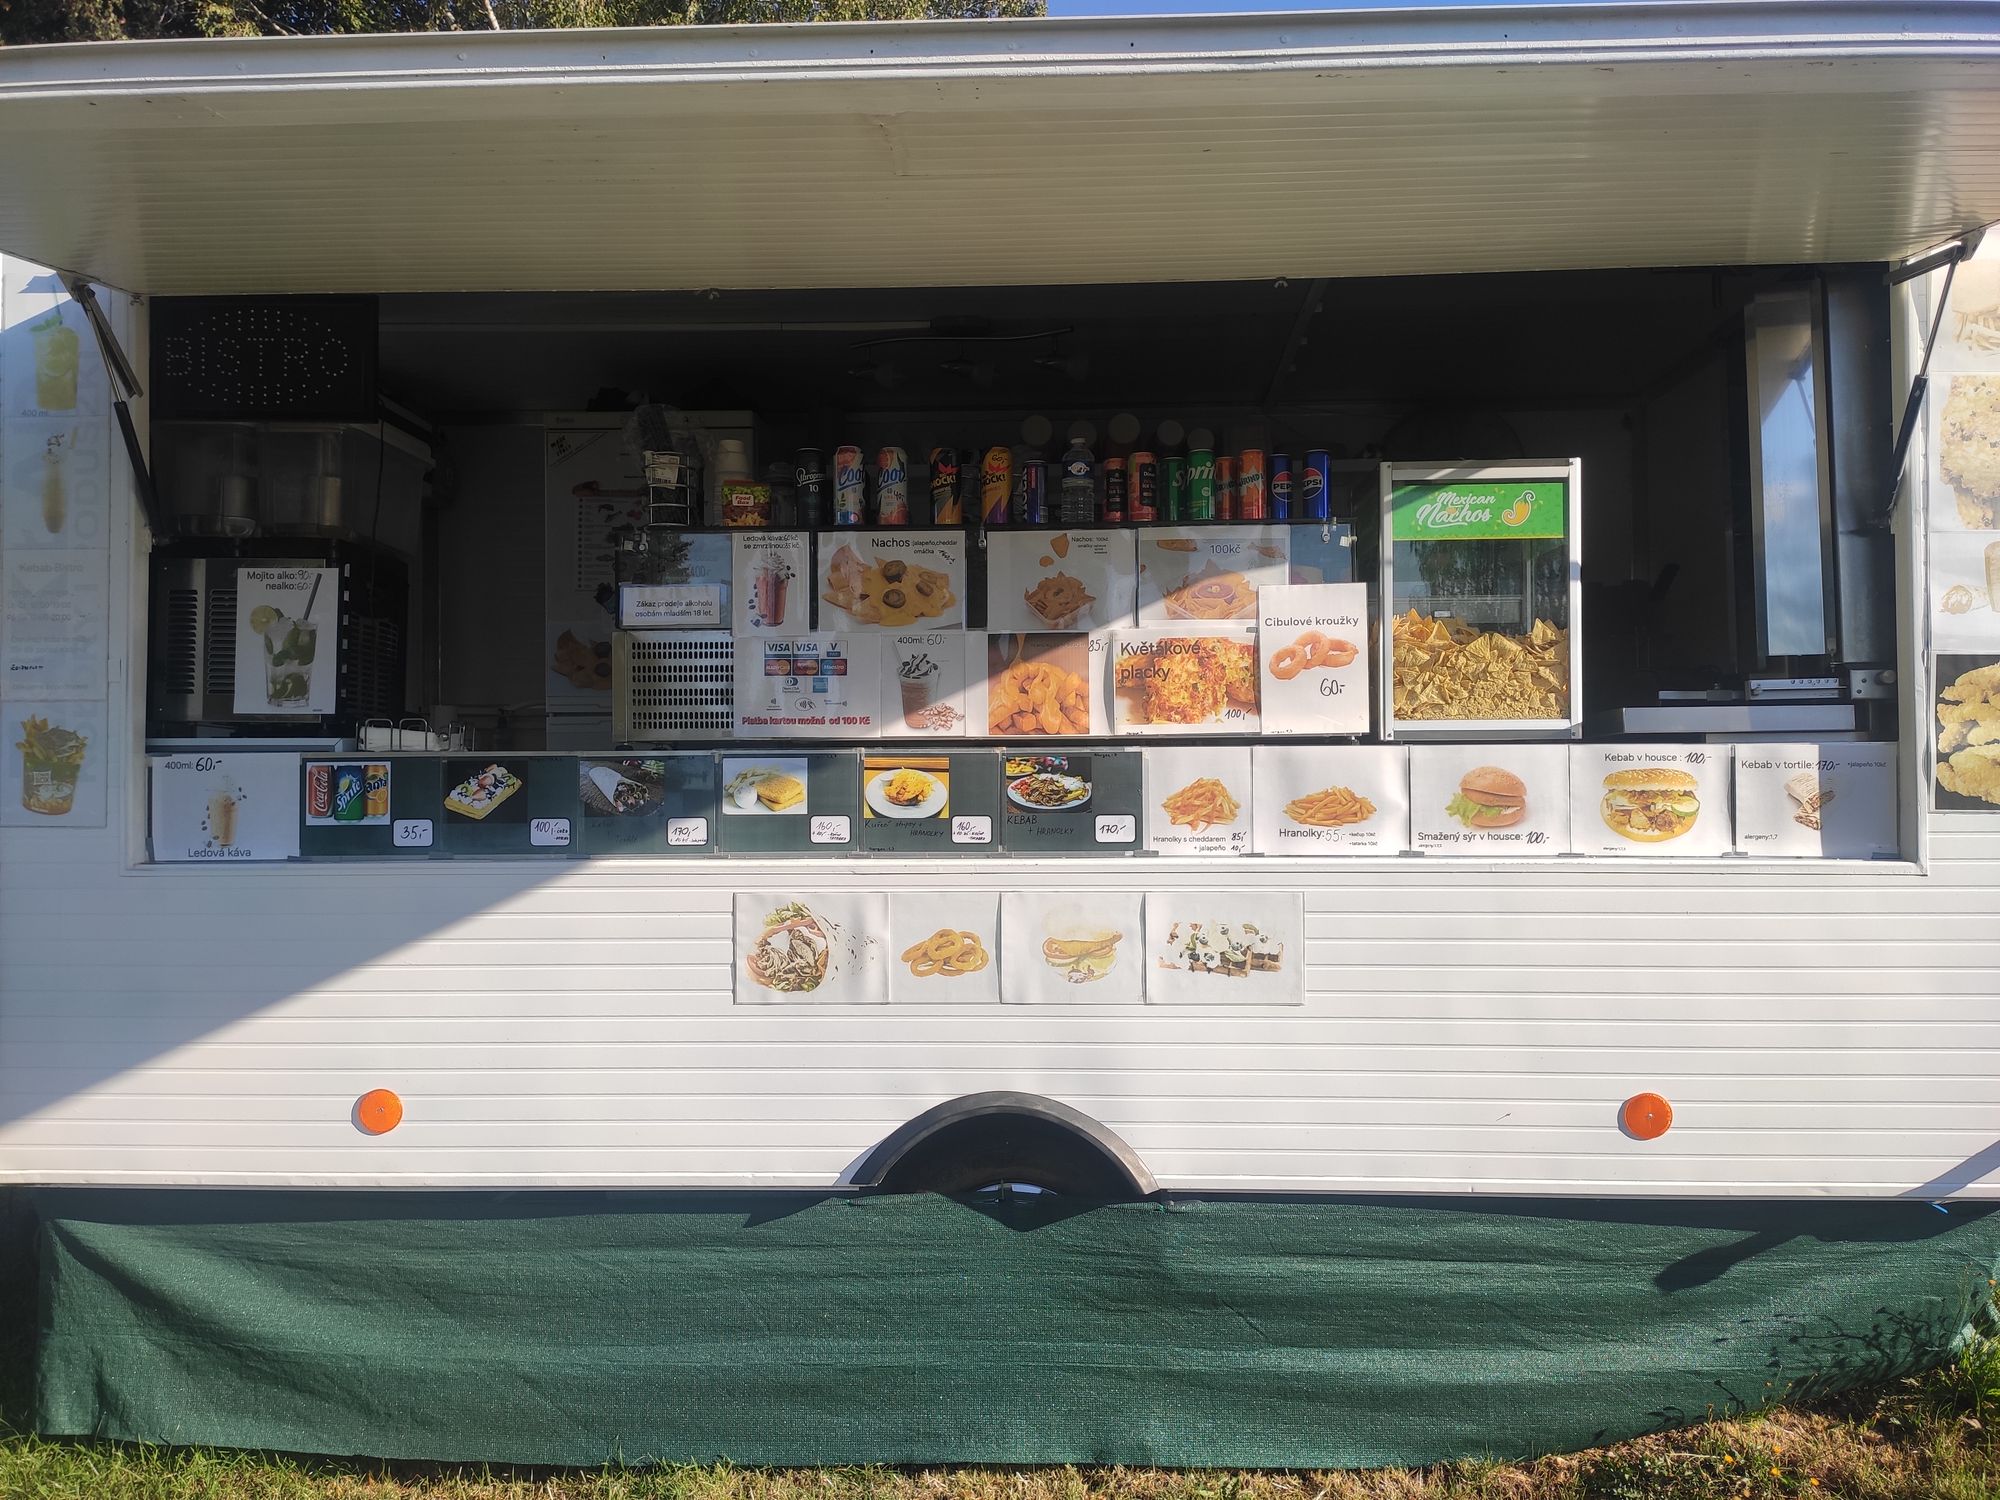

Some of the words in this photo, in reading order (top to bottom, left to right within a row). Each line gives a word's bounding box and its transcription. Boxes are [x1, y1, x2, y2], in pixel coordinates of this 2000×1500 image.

[166, 336, 348, 376] BISTRO
[808, 484, 819, 492] 10
[1436, 491, 1496, 506] Mexican
[1416, 502, 1493, 528] Nachos
[871, 538, 910, 548] Nachos
[1210, 544, 1241, 554] 100kč
[247, 570, 275, 581] Mojito
[277, 570, 297, 580] alko:
[265, 581, 297, 590] nealko:
[636, 600, 656, 608] Zákaz
[657, 601, 683, 609] prodeje
[1265, 616, 1313, 627] Cibulové
[1315, 615, 1359, 627] kroužky
[897, 637, 924, 645] 400ml:
[767, 643, 791, 652] VISA
[795, 643, 818, 652] VISA
[830, 643, 838, 651] V
[1120, 641, 1200, 656] Květákové
[1120, 664, 1171, 682] placky
[742, 716, 768, 725] Platba
[769, 716, 796, 725] kartou
[797, 715, 826, 725] možná
[829, 716, 841, 725] od
[841, 716, 857, 725] 100
[858, 715, 870, 725] Kč
[1604, 753, 1635, 762] Kebab
[1645, 753, 1677, 762] housce
[165, 761, 194, 770] 400ml:
[1741, 760, 1772, 769] Kebab
[1784, 760, 1814, 769] tortile:
[336, 780, 361, 811] Sprite
[1006, 814, 1038, 825] KEBAB
[1036, 826, 1074, 835] HRANOLKY
[1279, 828, 1325, 840] Hranolky:
[1418, 831, 1461, 842] Smažený
[1462, 832, 1477, 842] sýr
[1487, 831, 1523, 841] housce:
[188, 847, 225, 858] Ledová
[227, 847, 251, 857] káva
[1199, 844, 1227, 853] jalapeño
